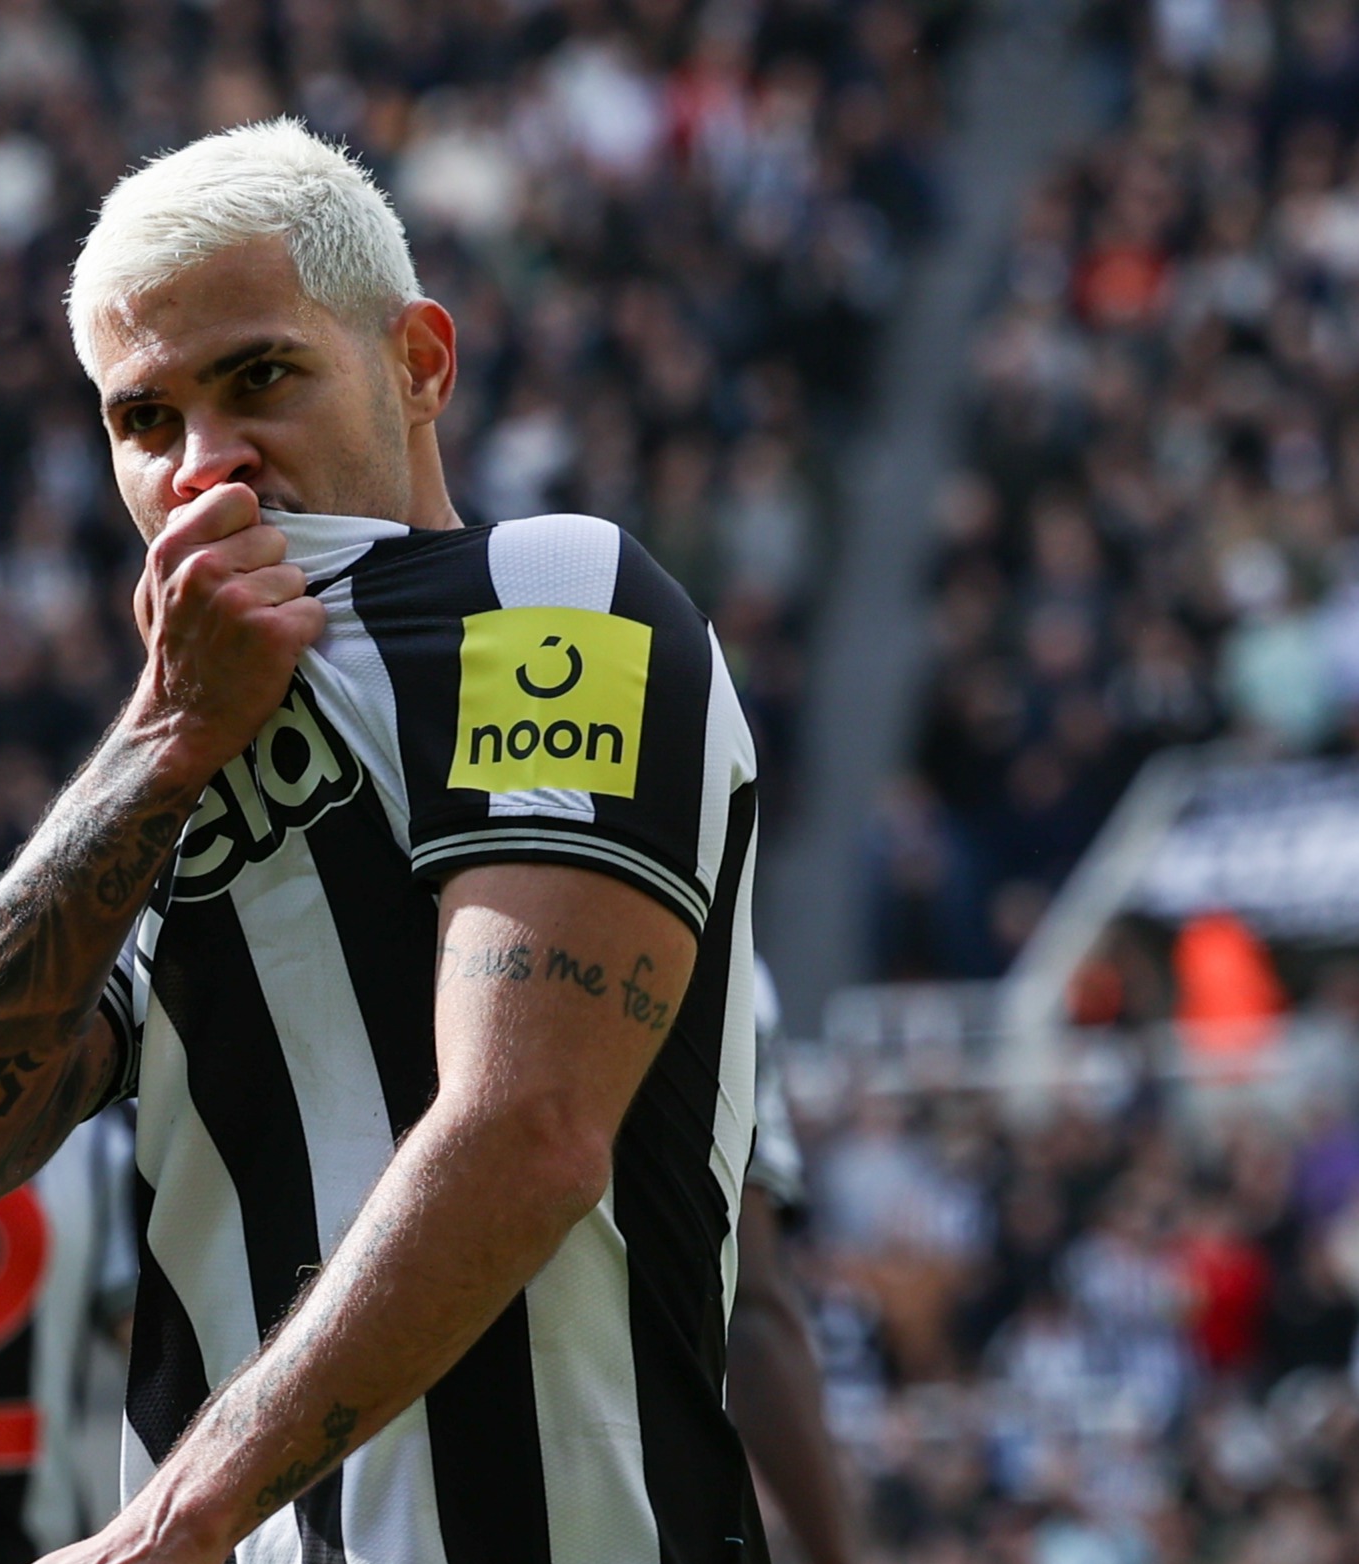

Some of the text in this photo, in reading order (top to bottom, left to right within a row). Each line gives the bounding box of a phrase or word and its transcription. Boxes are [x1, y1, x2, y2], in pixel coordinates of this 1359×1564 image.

[469, 720, 624, 765] noon
[172, 688, 343, 878] ela
[545, 949, 608, 996] me
